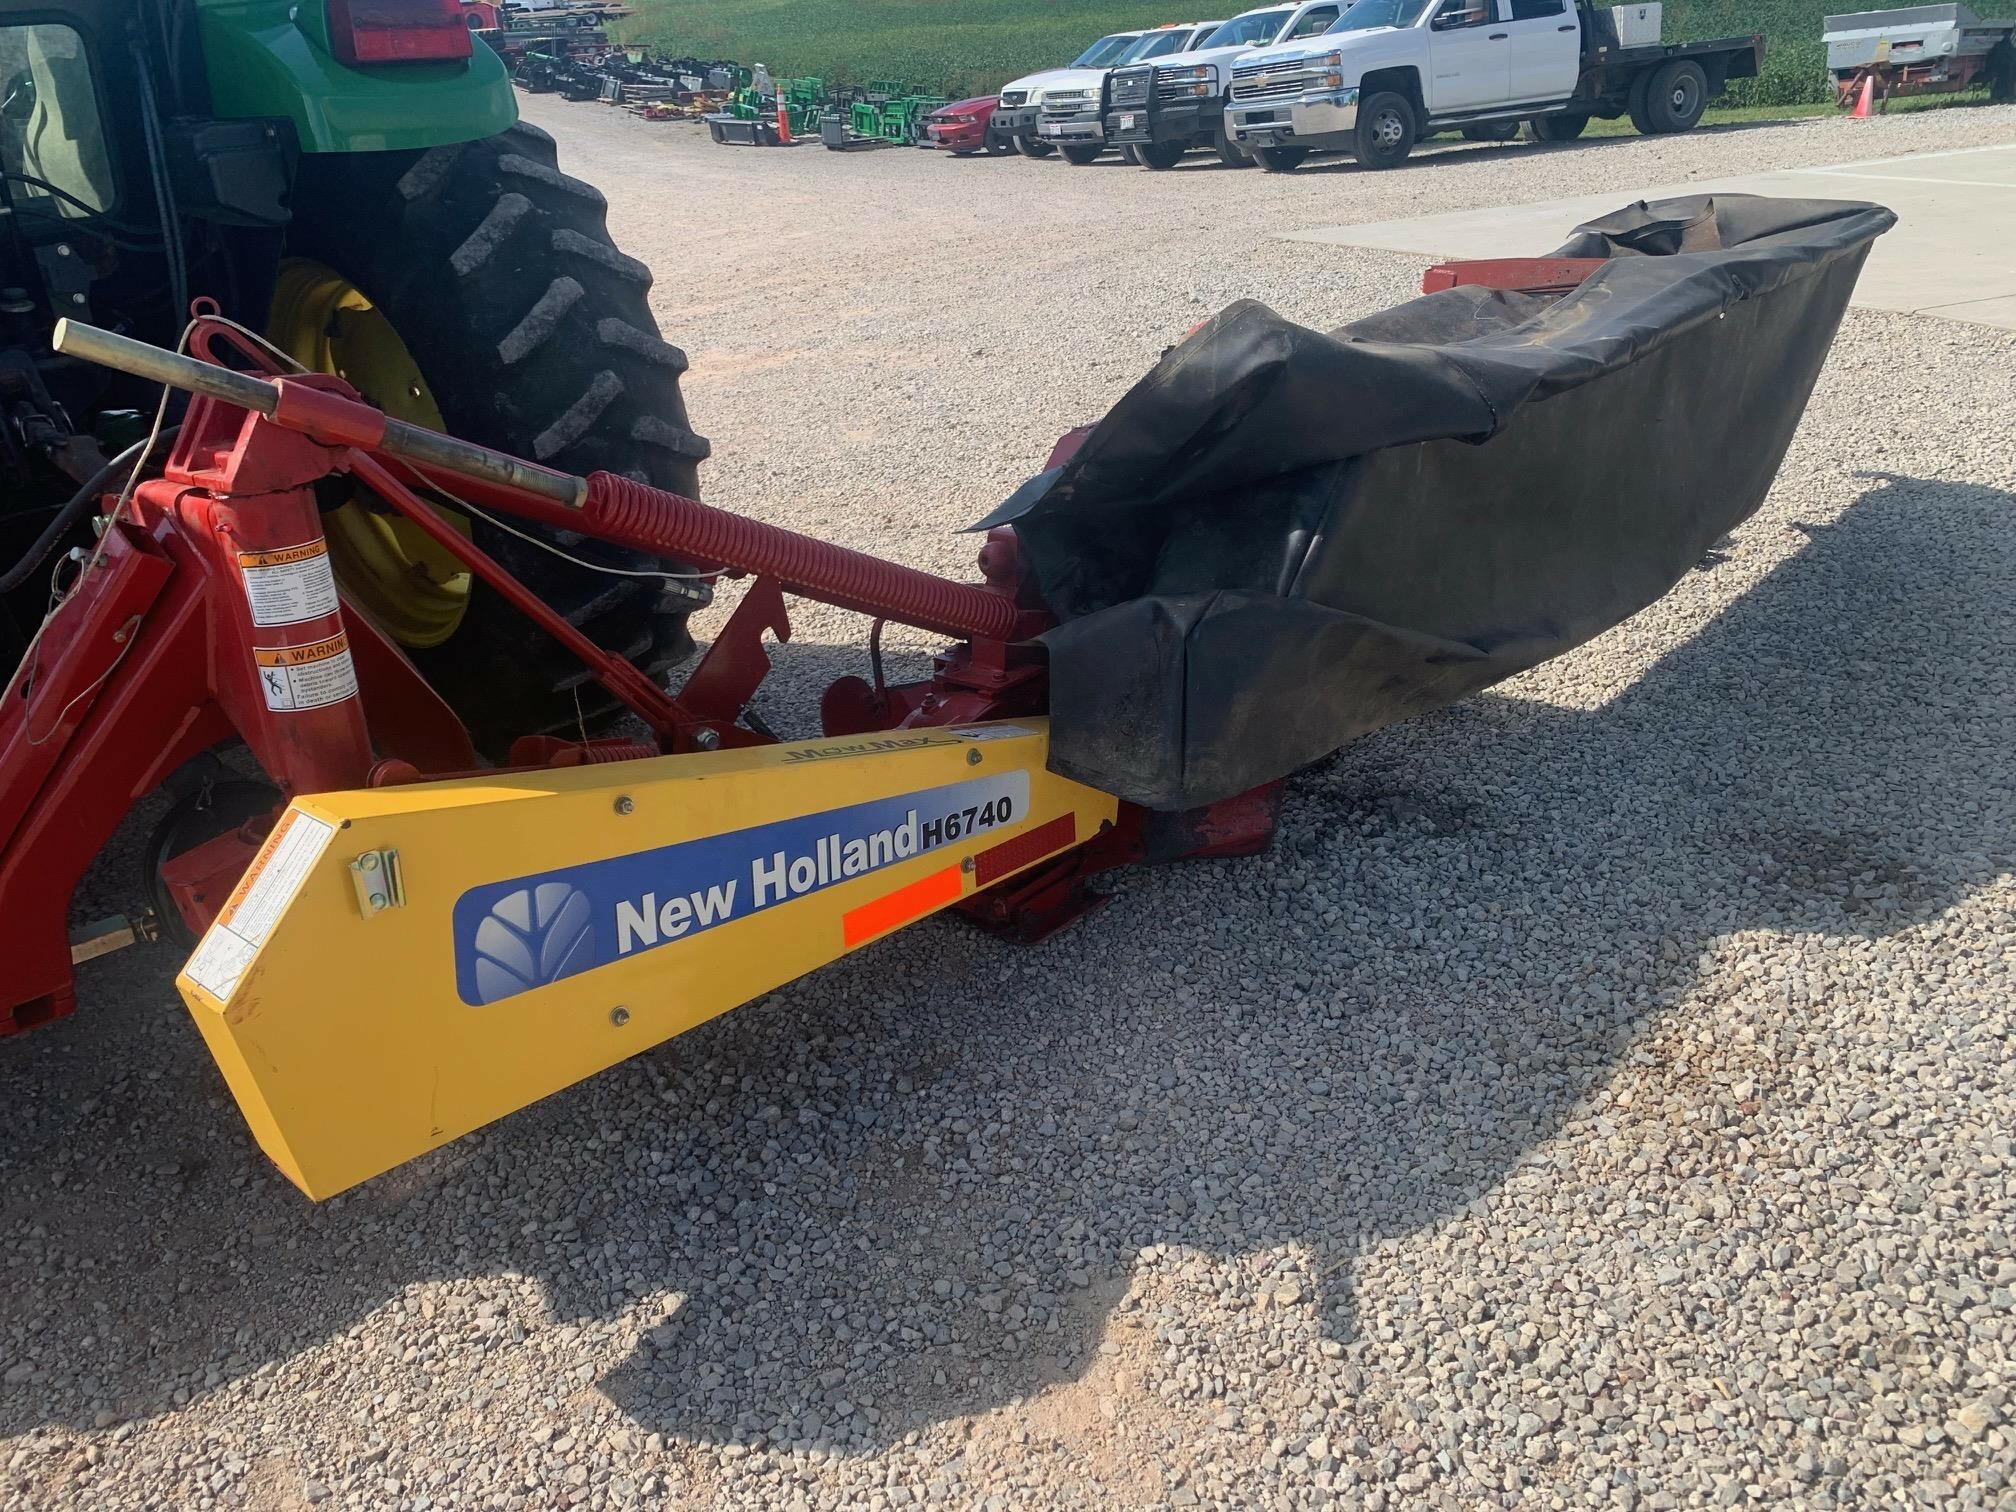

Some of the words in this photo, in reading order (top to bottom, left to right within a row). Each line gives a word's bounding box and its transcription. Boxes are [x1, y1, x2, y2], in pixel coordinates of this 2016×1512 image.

[273, 545, 321, 563] WARNING
[238, 821, 291, 898] WARNING
[614, 878, 738, 956] New
[751, 808, 919, 909] Holland
[921, 796, 1014, 850] H6740
